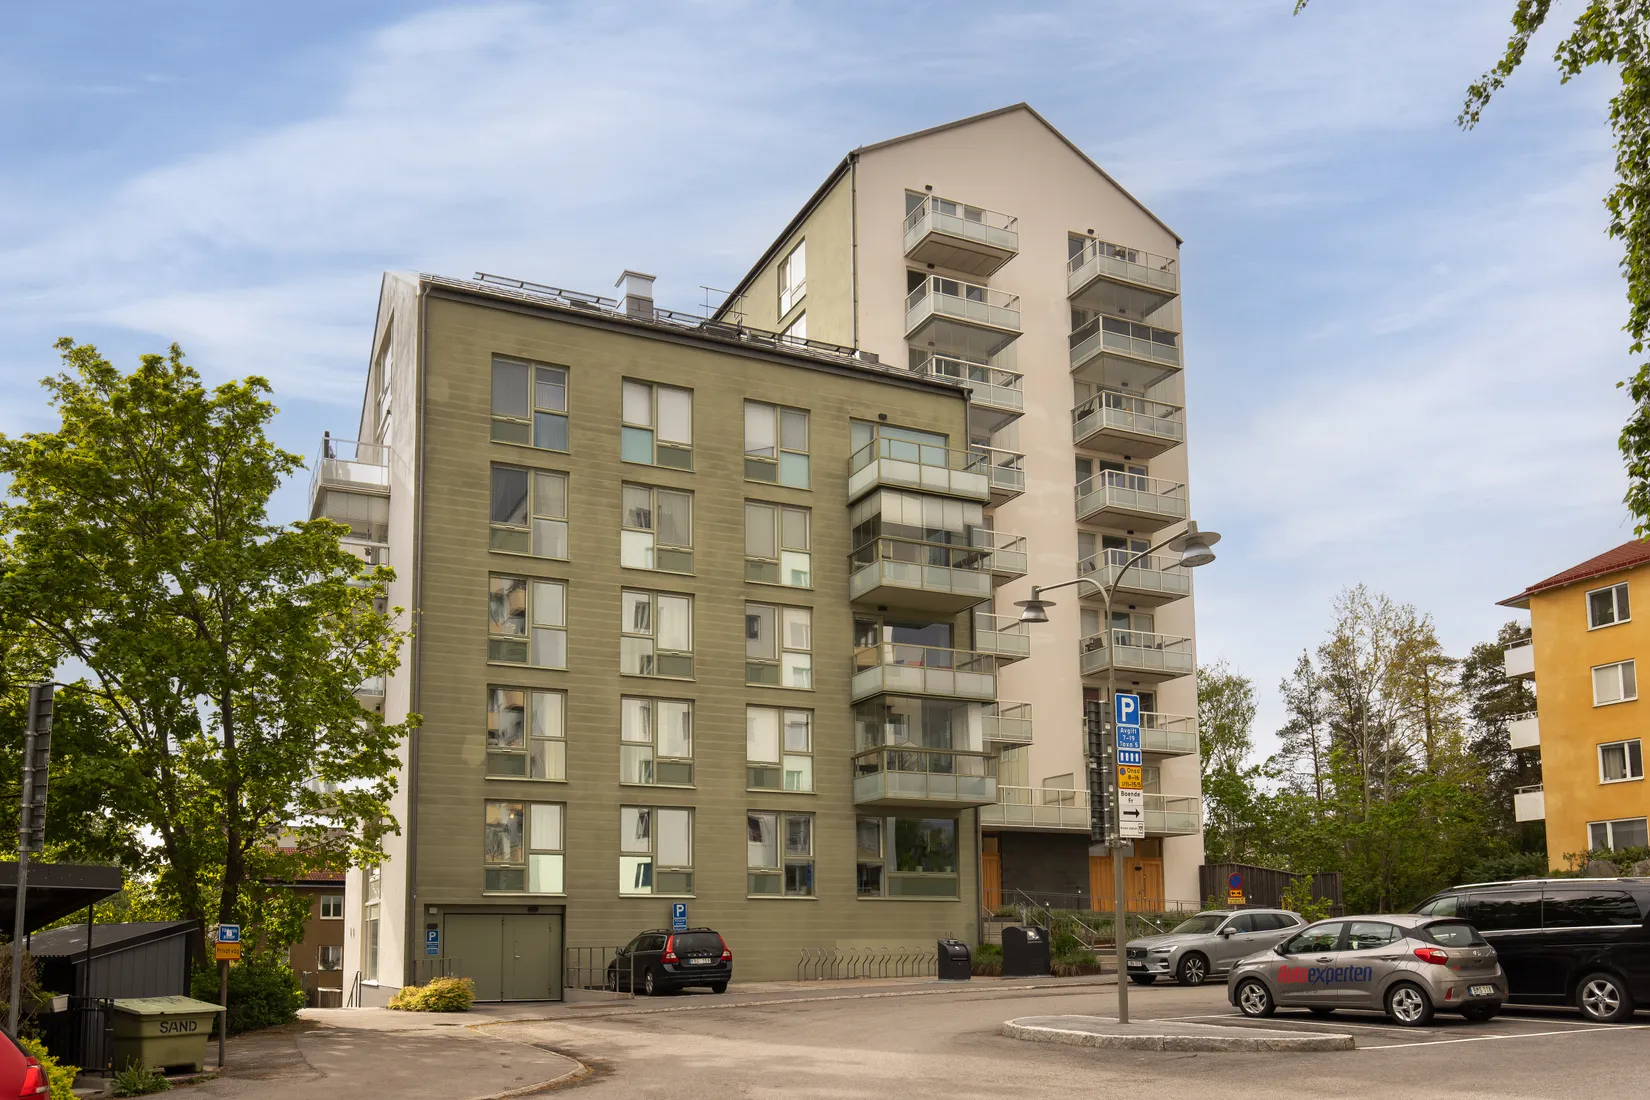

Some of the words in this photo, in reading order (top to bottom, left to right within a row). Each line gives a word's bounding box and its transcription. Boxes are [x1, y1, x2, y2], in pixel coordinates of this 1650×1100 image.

[1121, 697, 1135, 722] P
[676, 904, 685, 917] P
[428, 931, 437, 941] P
[1277, 964, 1373, 986] Autoexperten
[159, 1020, 198, 1034] SAND
